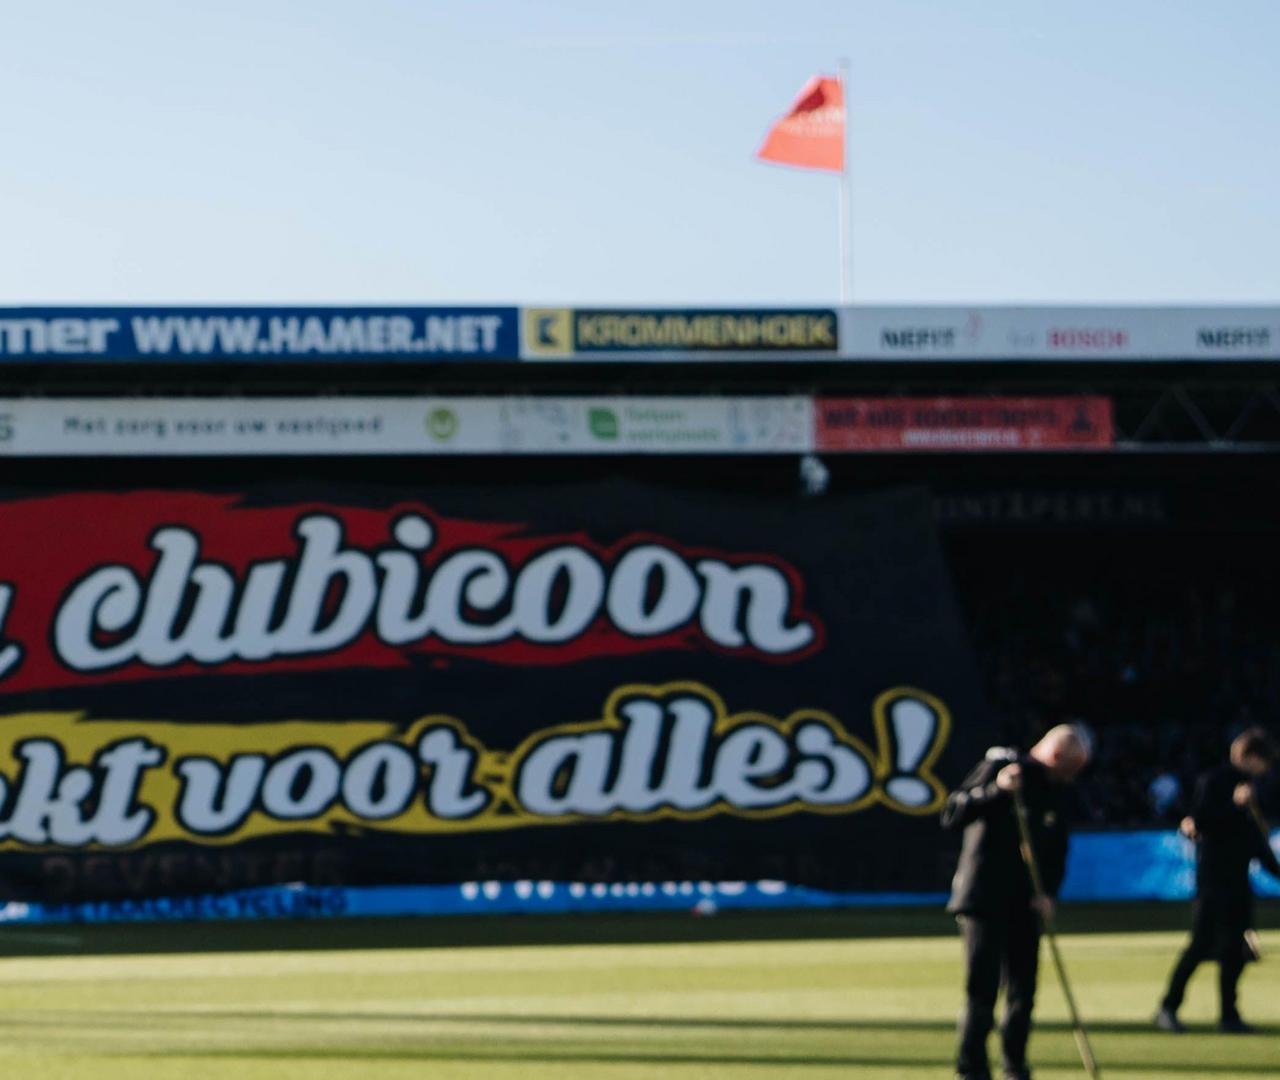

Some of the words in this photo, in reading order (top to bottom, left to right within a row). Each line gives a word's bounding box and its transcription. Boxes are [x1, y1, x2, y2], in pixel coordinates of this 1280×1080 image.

[132, 315, 502, 355] WWW.HAMER.NET
[577, 313, 835, 346] KROMMENHOEK
[49, 512, 817, 674] clubicoon
[173, 724, 488, 836] voor
[517, 696, 936, 814] alles!
